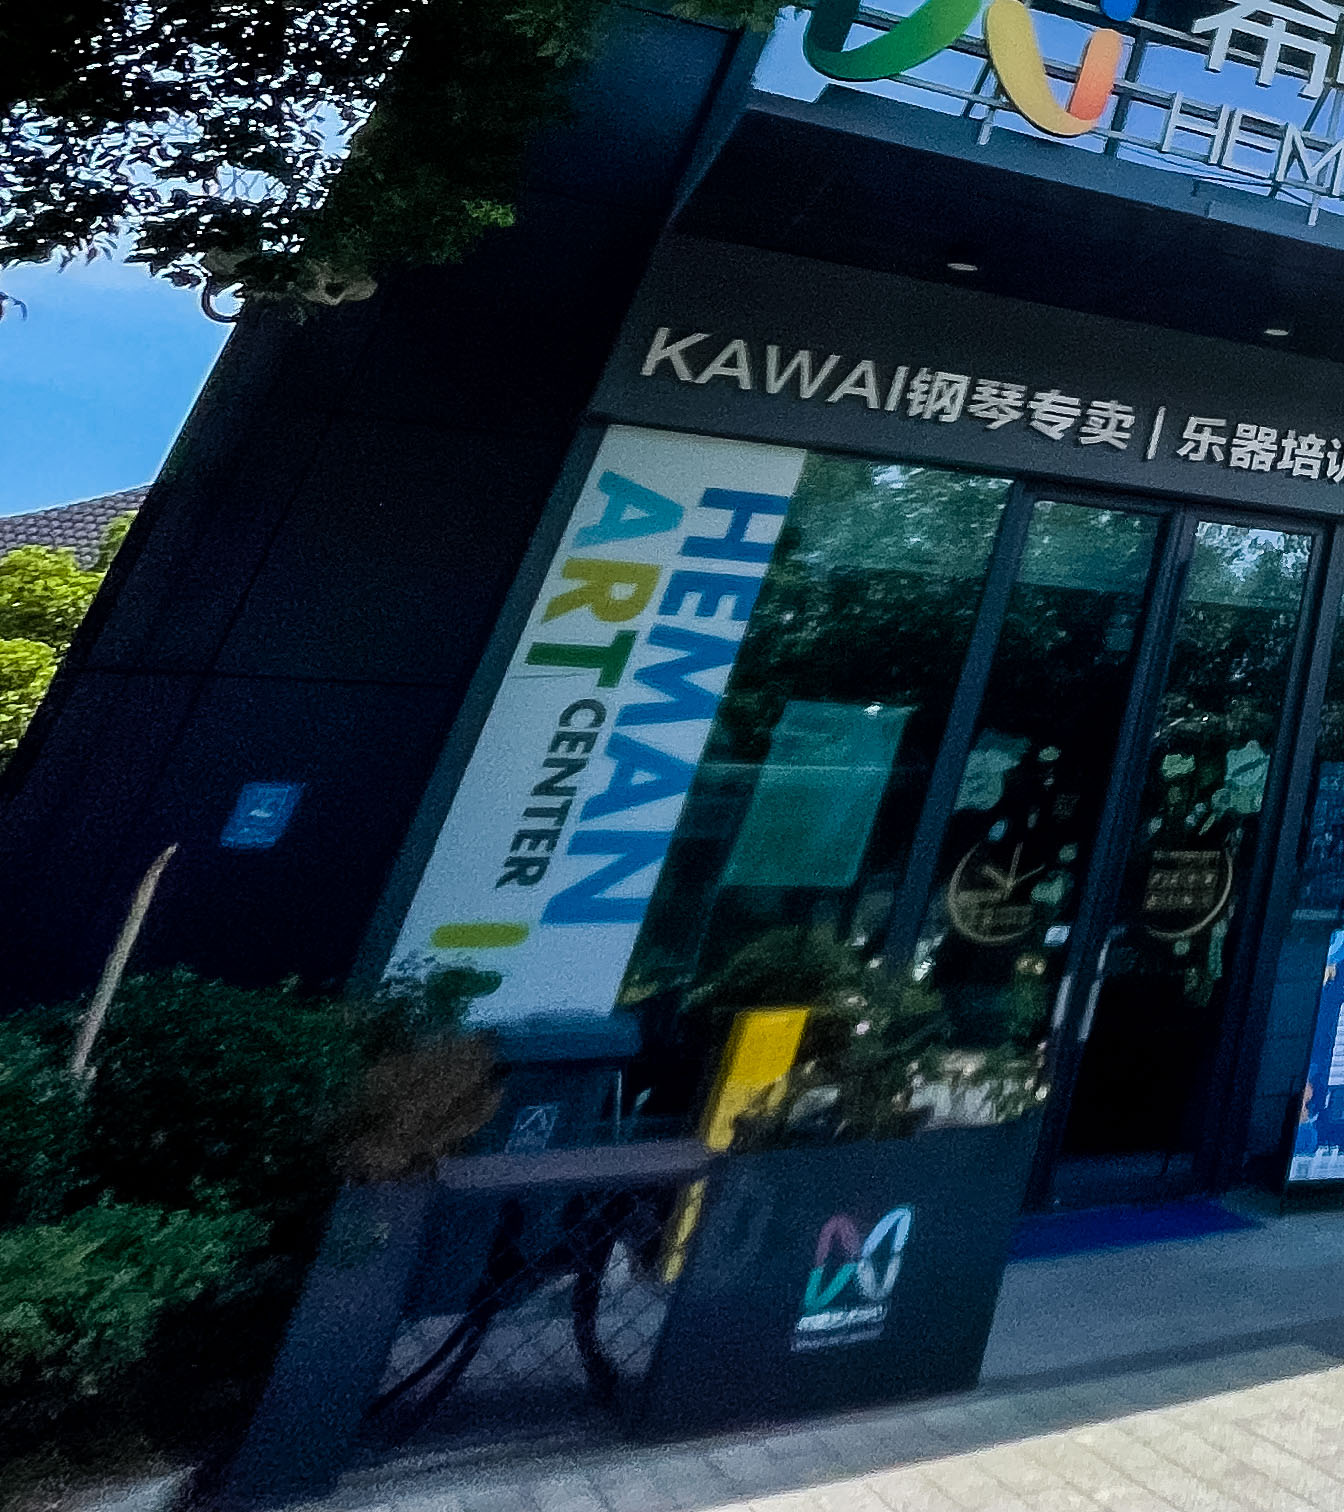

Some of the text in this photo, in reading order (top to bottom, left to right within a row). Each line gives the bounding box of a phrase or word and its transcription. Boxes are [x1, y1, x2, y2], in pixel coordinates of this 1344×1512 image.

[640, 328, 1136, 449] KAWAI钢琴专卖
[496, 470, 683, 888] ART CENTER
[540, 488, 789, 924] HEMAN
